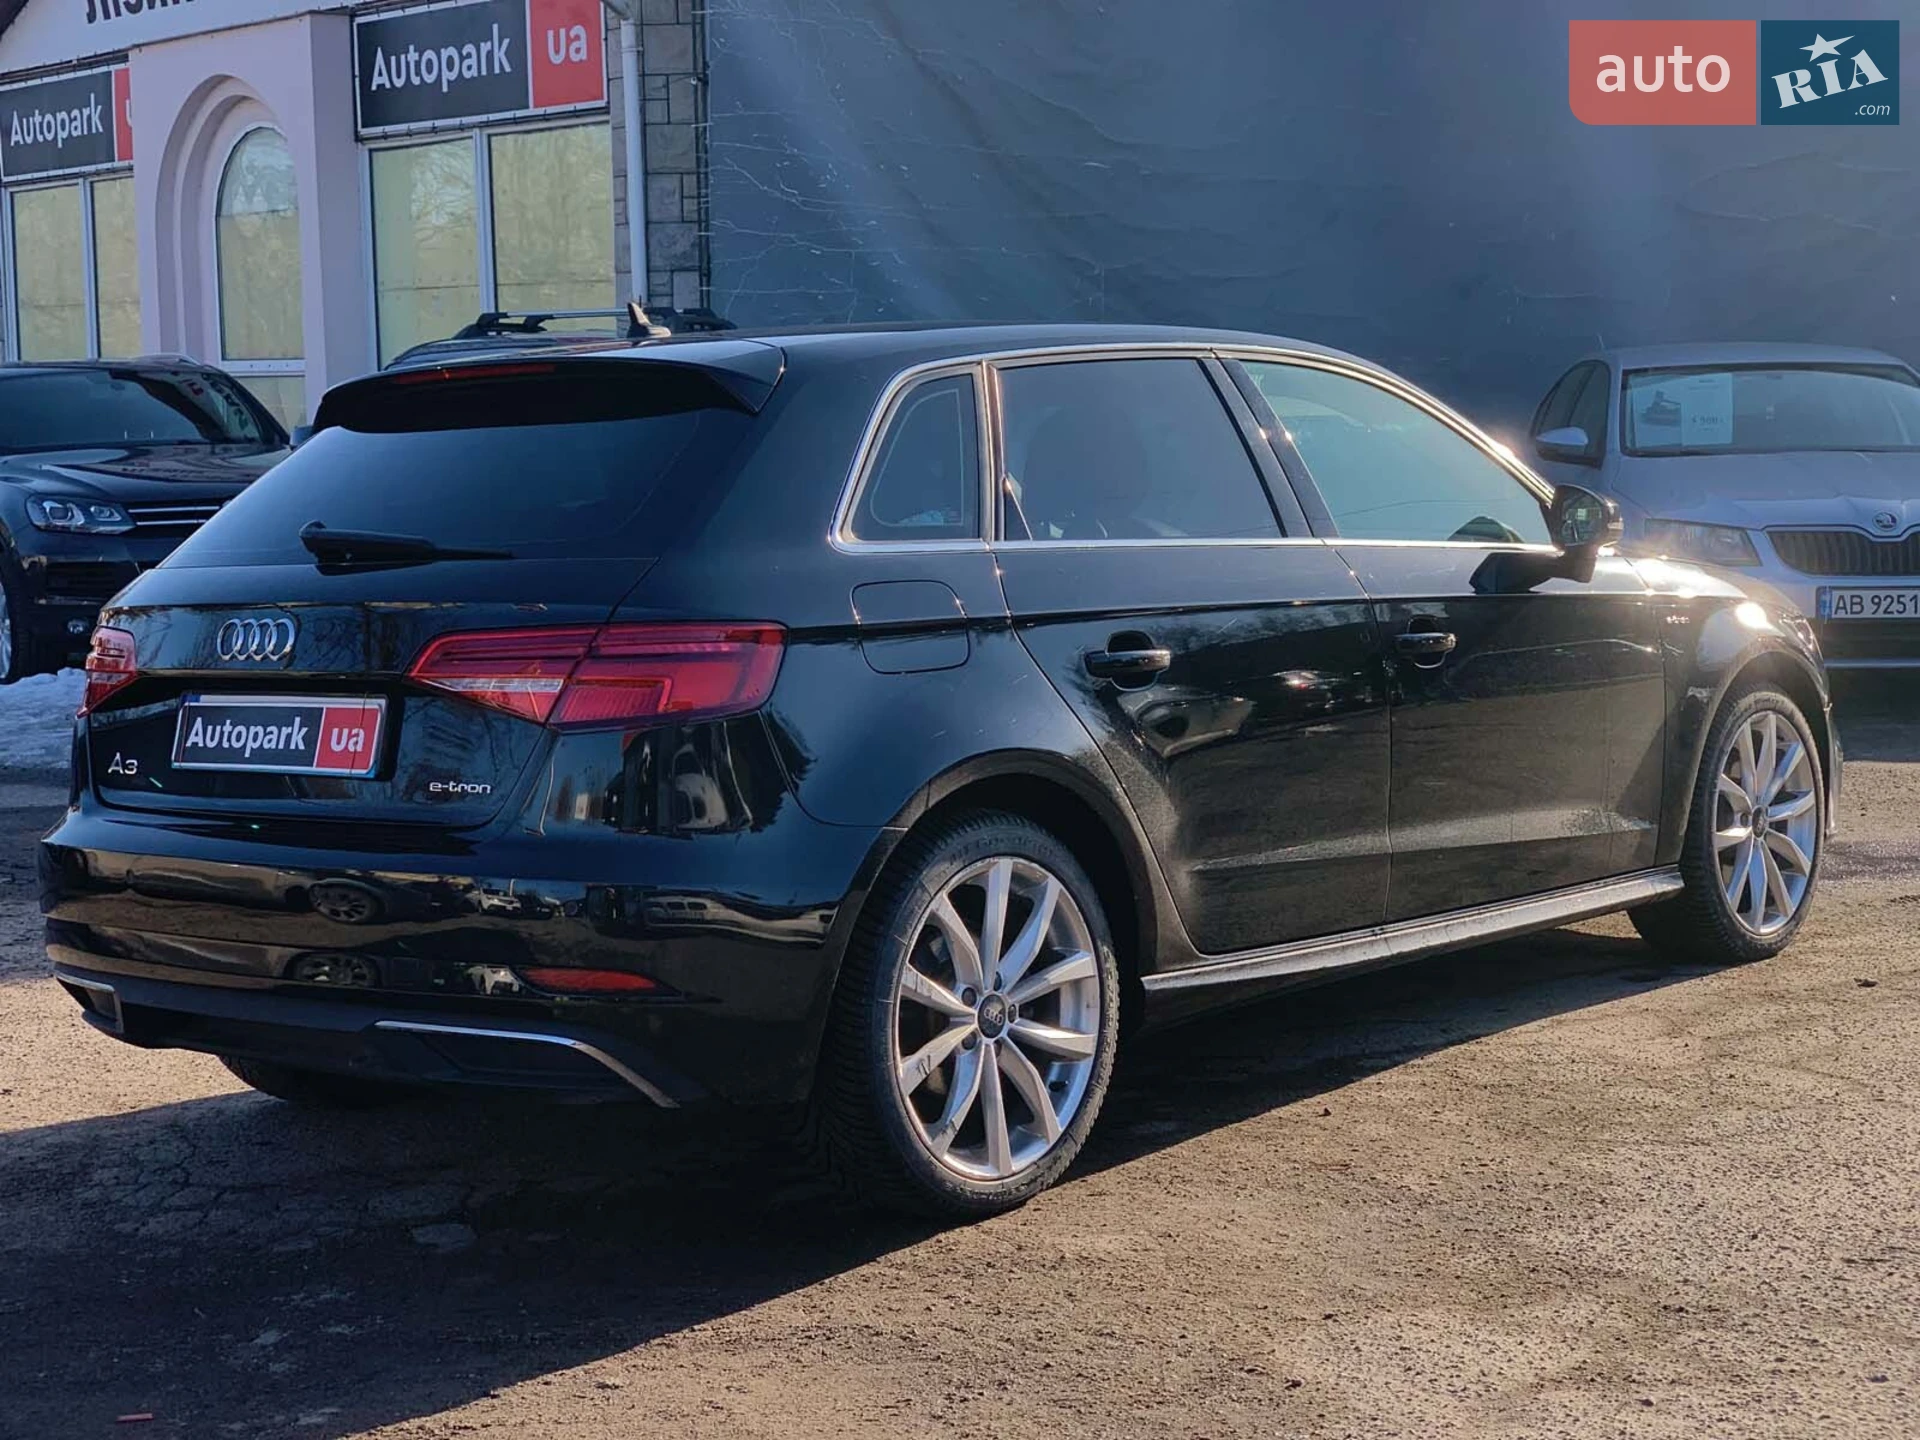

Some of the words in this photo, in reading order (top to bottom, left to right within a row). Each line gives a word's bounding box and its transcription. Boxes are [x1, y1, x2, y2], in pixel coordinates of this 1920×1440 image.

[371, 23, 511, 92] Autopark
[547, 24, 588, 65] ua
[10, 93, 104, 148] Autopark
[1834, 595, 1865, 615] AB
[1871, 595, 1919, 615] 9251
[185, 716, 308, 758] Autopark
[330, 727, 365, 752] ua
[107, 752, 138, 775] A3
[429, 780, 491, 794] e-tron
